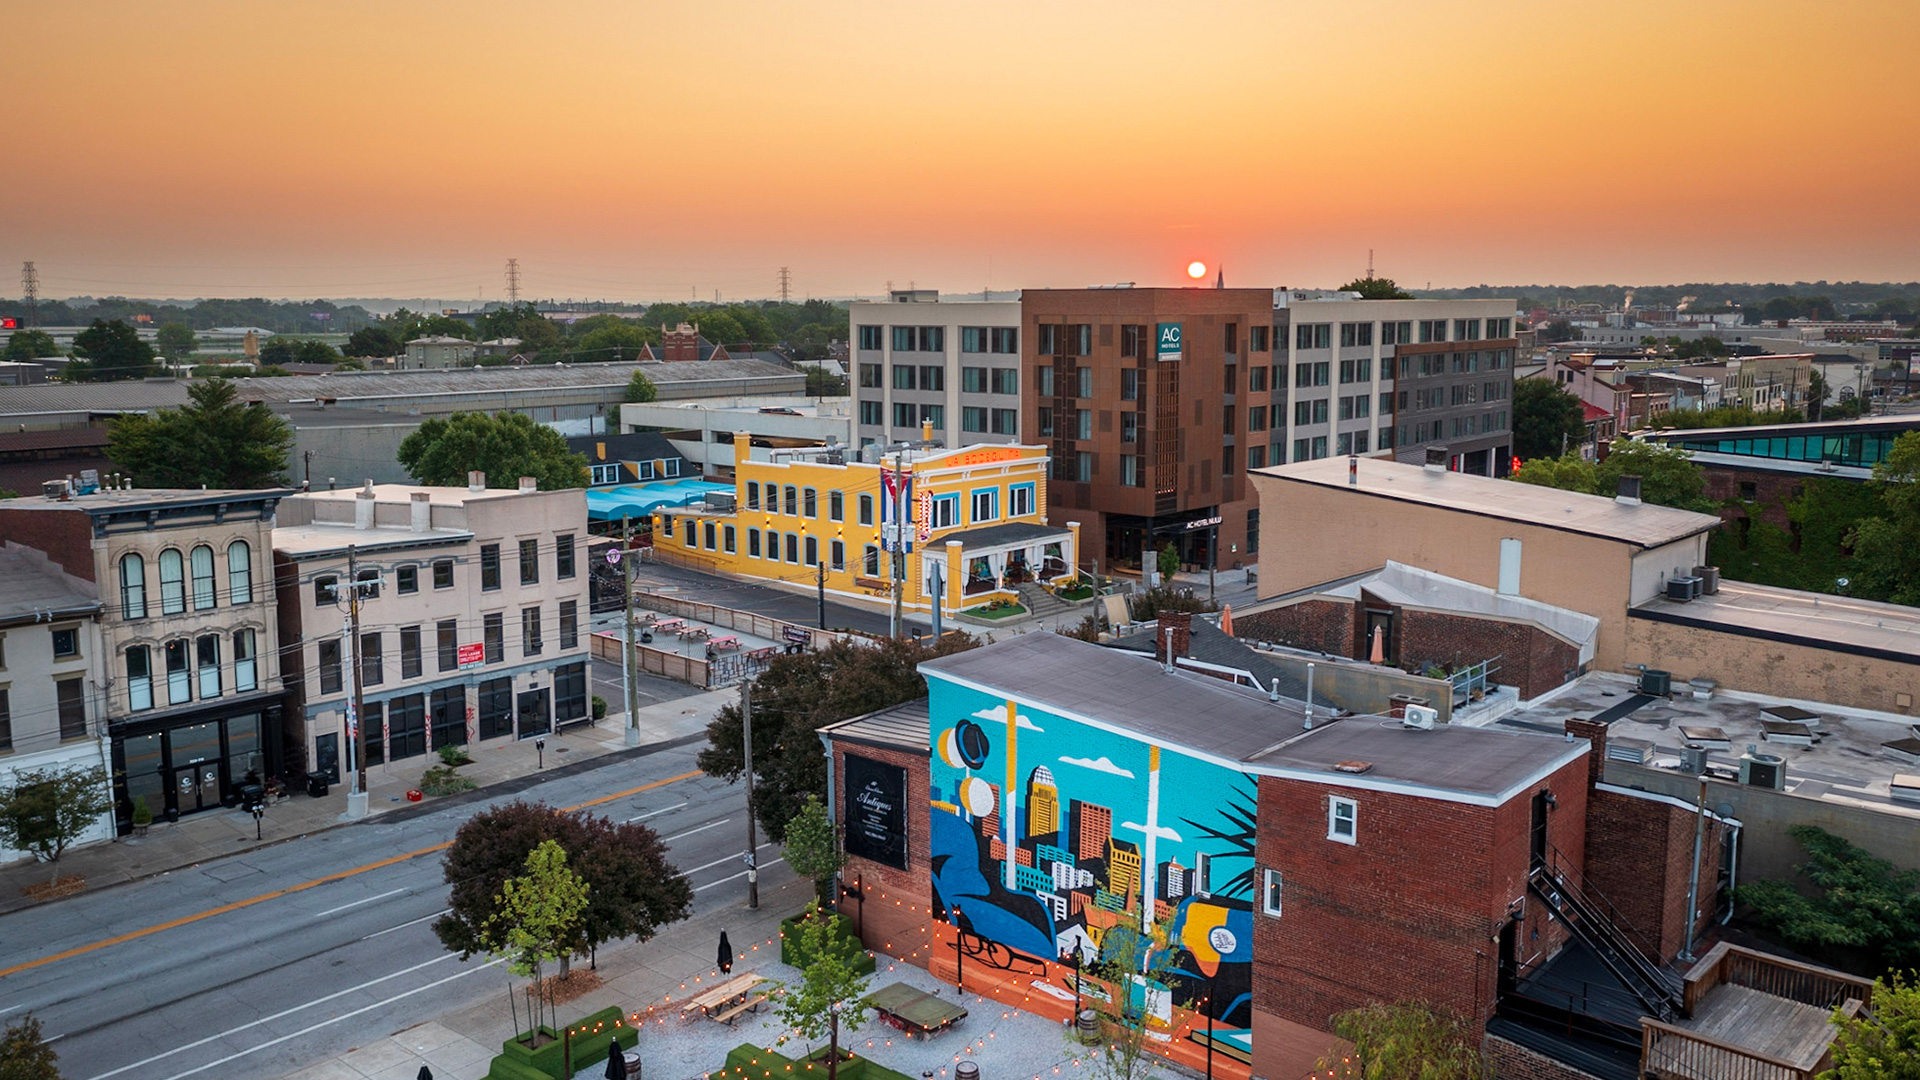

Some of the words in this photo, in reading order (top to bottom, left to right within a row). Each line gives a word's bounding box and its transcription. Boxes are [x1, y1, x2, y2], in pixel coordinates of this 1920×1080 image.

[1161, 327, 1180, 342] AC
[946, 455, 961, 468] LA
[1186, 521, 1194, 529] AC
[1194, 519, 1208, 527] HOTEL
[856, 792, 892, 811] Antiques
